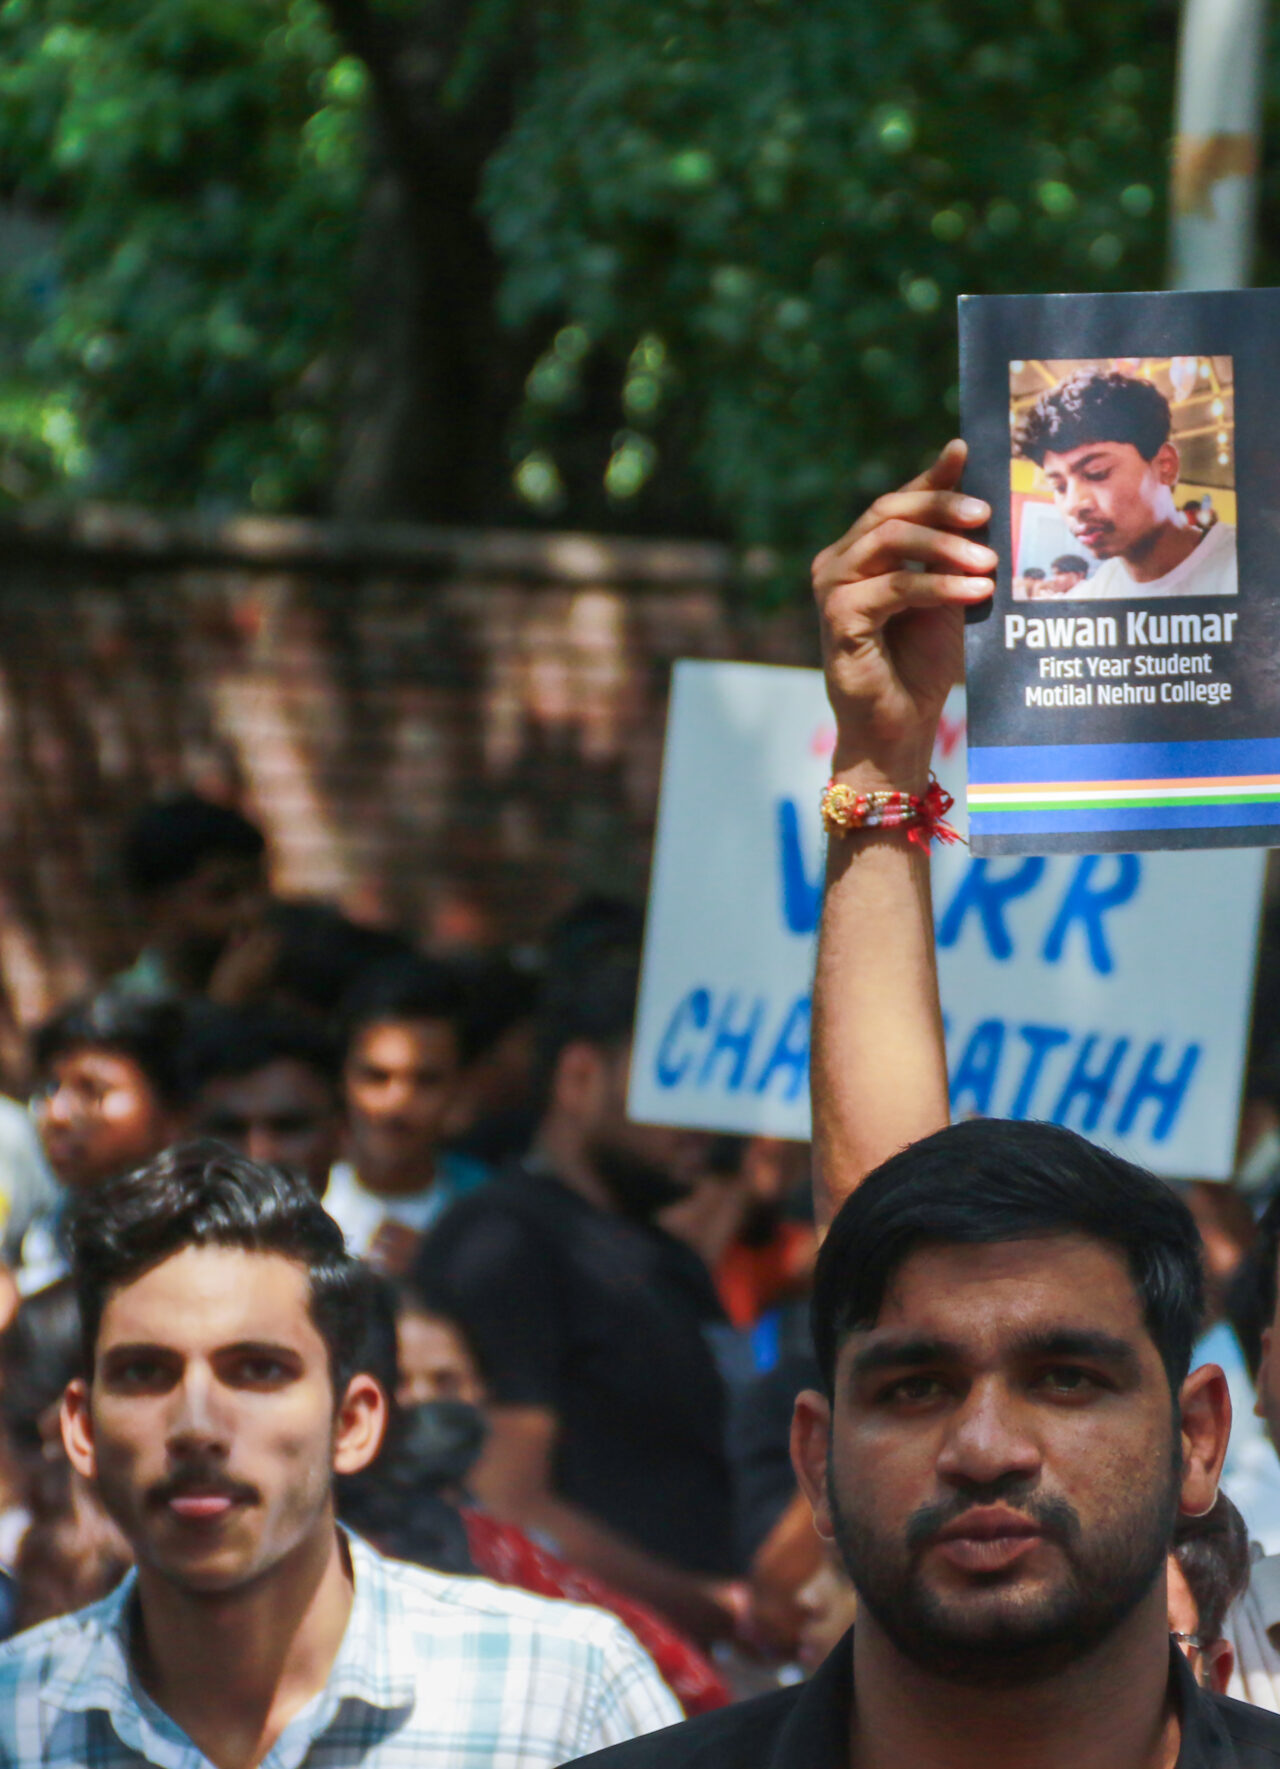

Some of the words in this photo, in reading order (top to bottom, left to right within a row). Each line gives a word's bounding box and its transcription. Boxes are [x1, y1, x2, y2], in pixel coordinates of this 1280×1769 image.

[1004, 612, 1118, 650] Pawan
[1126, 611, 1239, 646] Kumar
[1038, 656, 1083, 679] First
[1086, 655, 1132, 678] Year
[1134, 653, 1213, 677] Student
[1024, 684, 1093, 708] Motilal
[1096, 682, 1156, 706] Nehru
[1160, 680, 1233, 706] College
